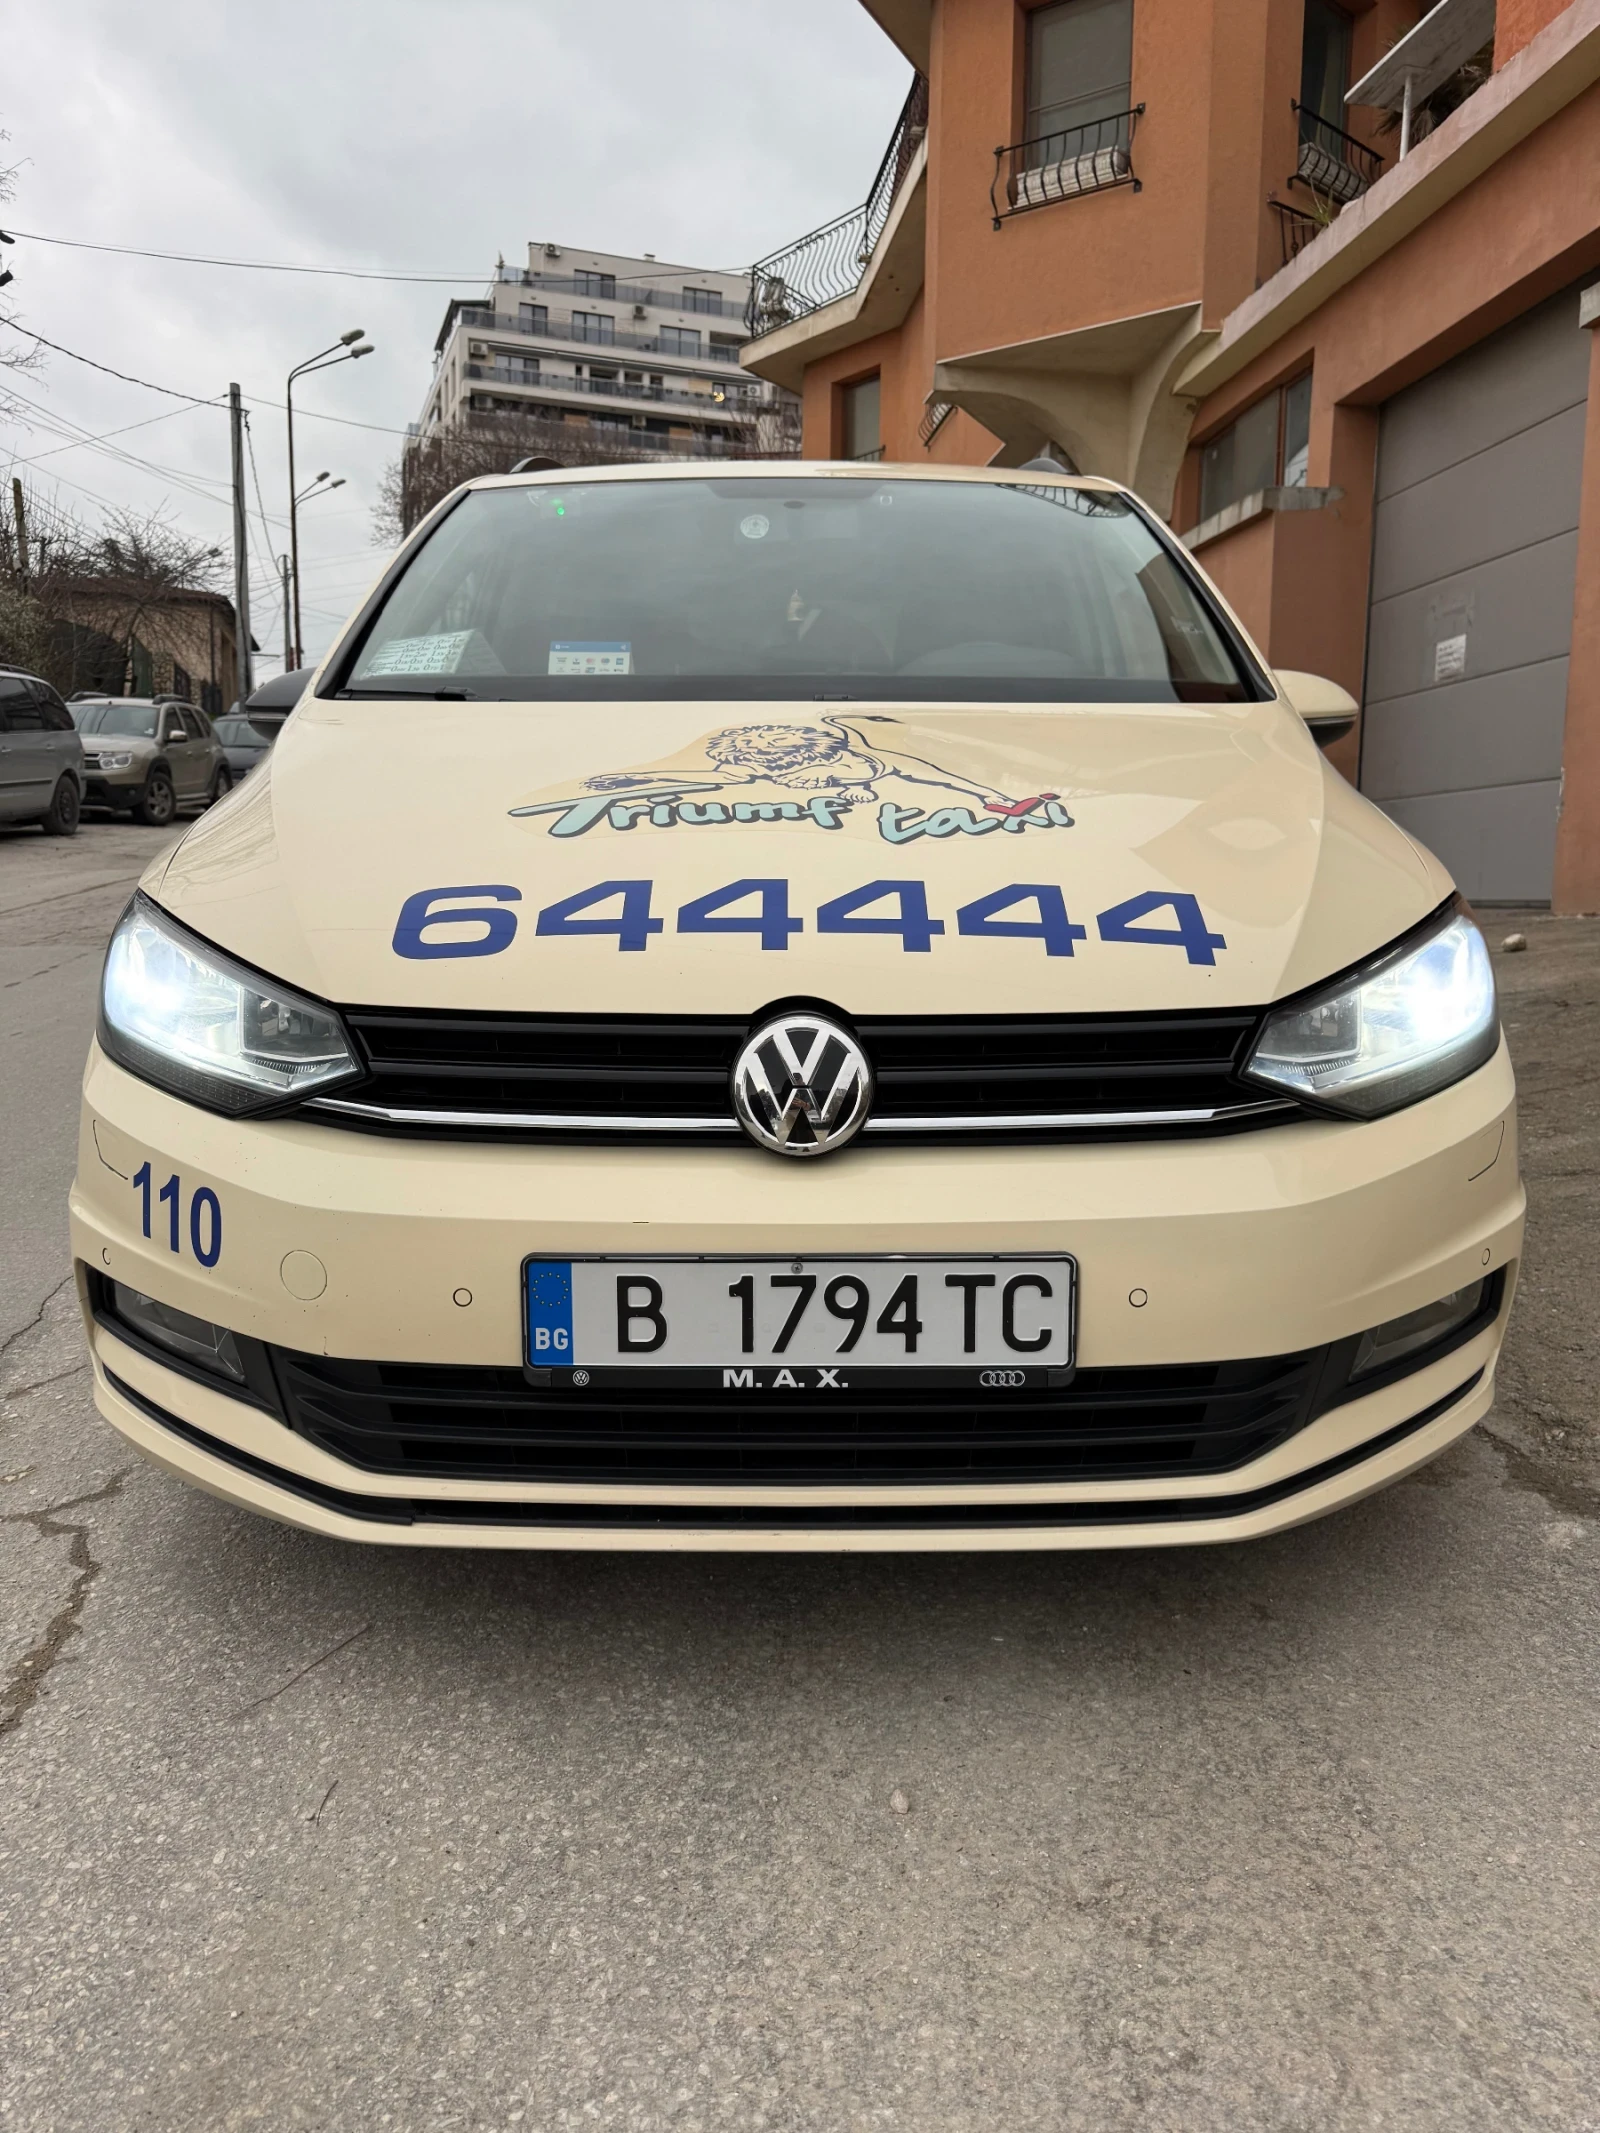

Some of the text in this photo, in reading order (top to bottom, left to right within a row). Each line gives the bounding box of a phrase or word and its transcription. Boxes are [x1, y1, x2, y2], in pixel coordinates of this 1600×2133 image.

[509, 782, 1075, 845] Triumf taxi
[392, 878, 1228, 967] 644444
[732, 1011, 873, 1156] VW
[133, 1160, 222, 1268] 110
[535, 1327, 569, 1351] BG
[617, 1275, 668, 1353] B
